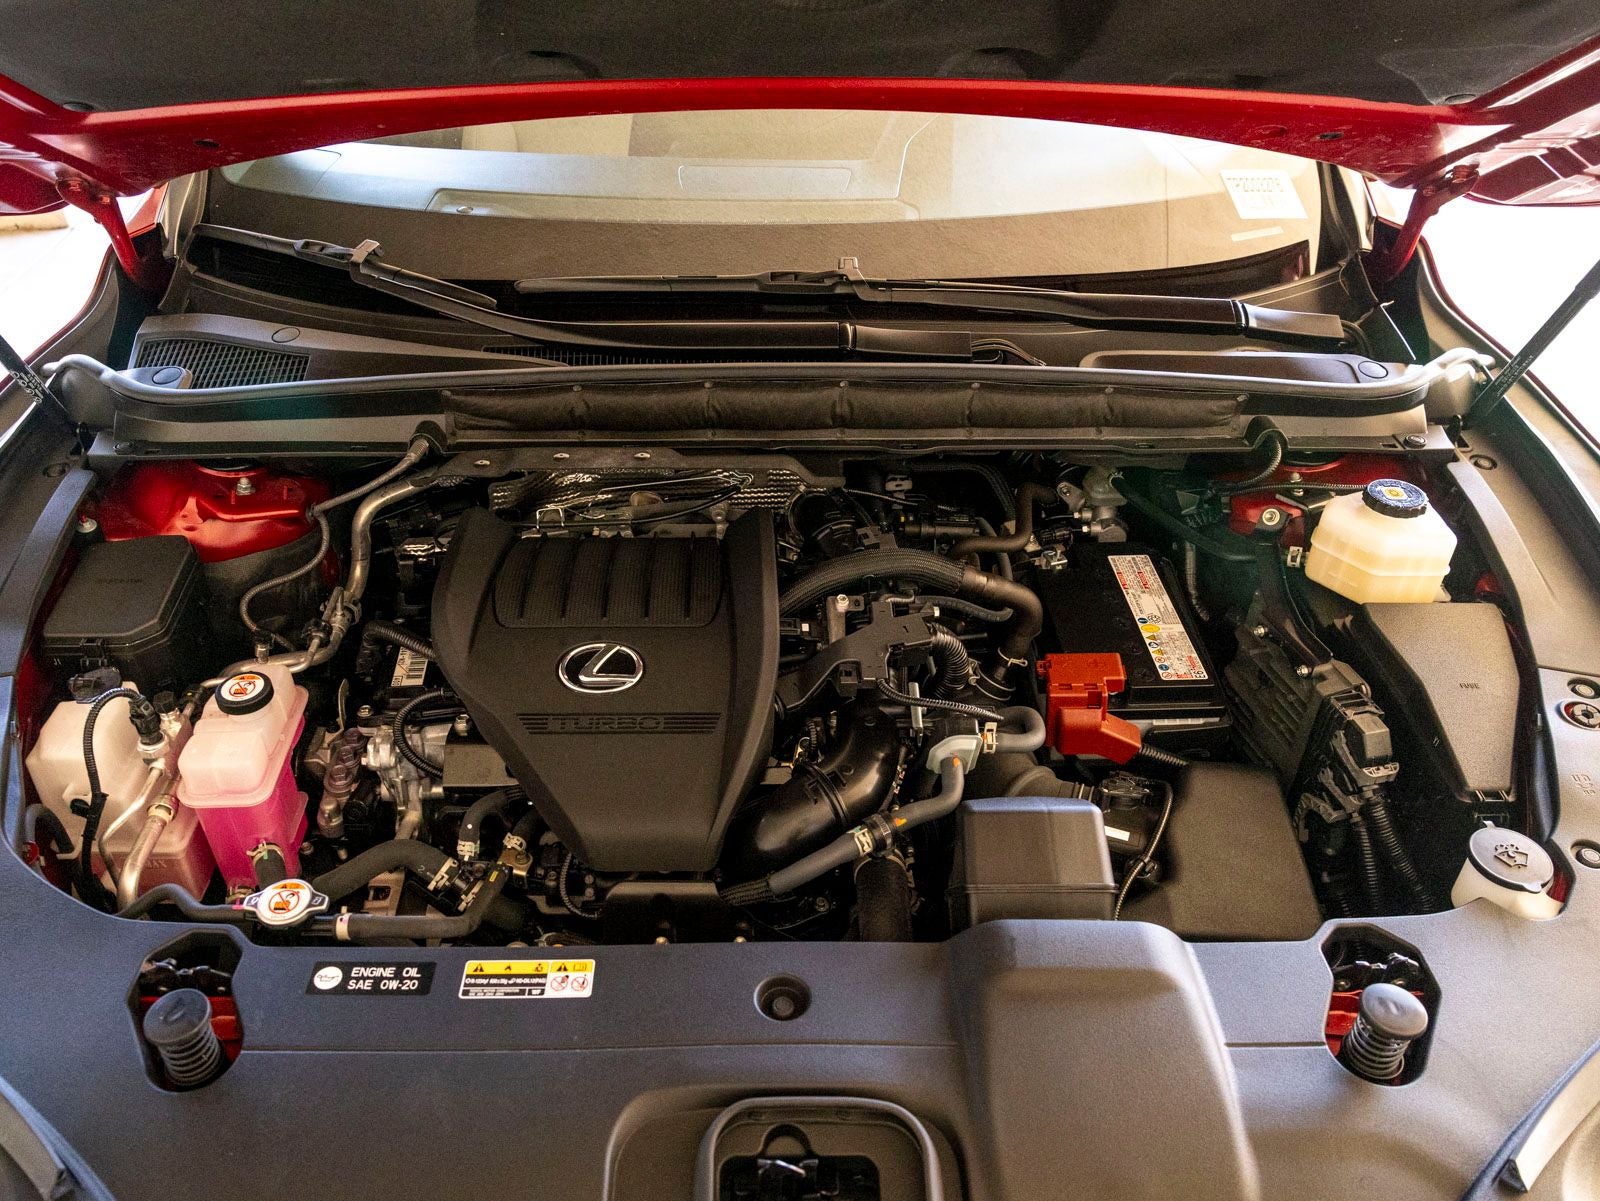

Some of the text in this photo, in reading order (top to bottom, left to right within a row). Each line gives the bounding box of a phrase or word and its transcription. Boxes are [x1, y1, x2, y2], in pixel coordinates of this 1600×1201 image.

[551, 716, 661, 730] TURBO
[351, 967, 421, 977] ENGINE OIL
[347, 980, 419, 990] SAE 0W-20
